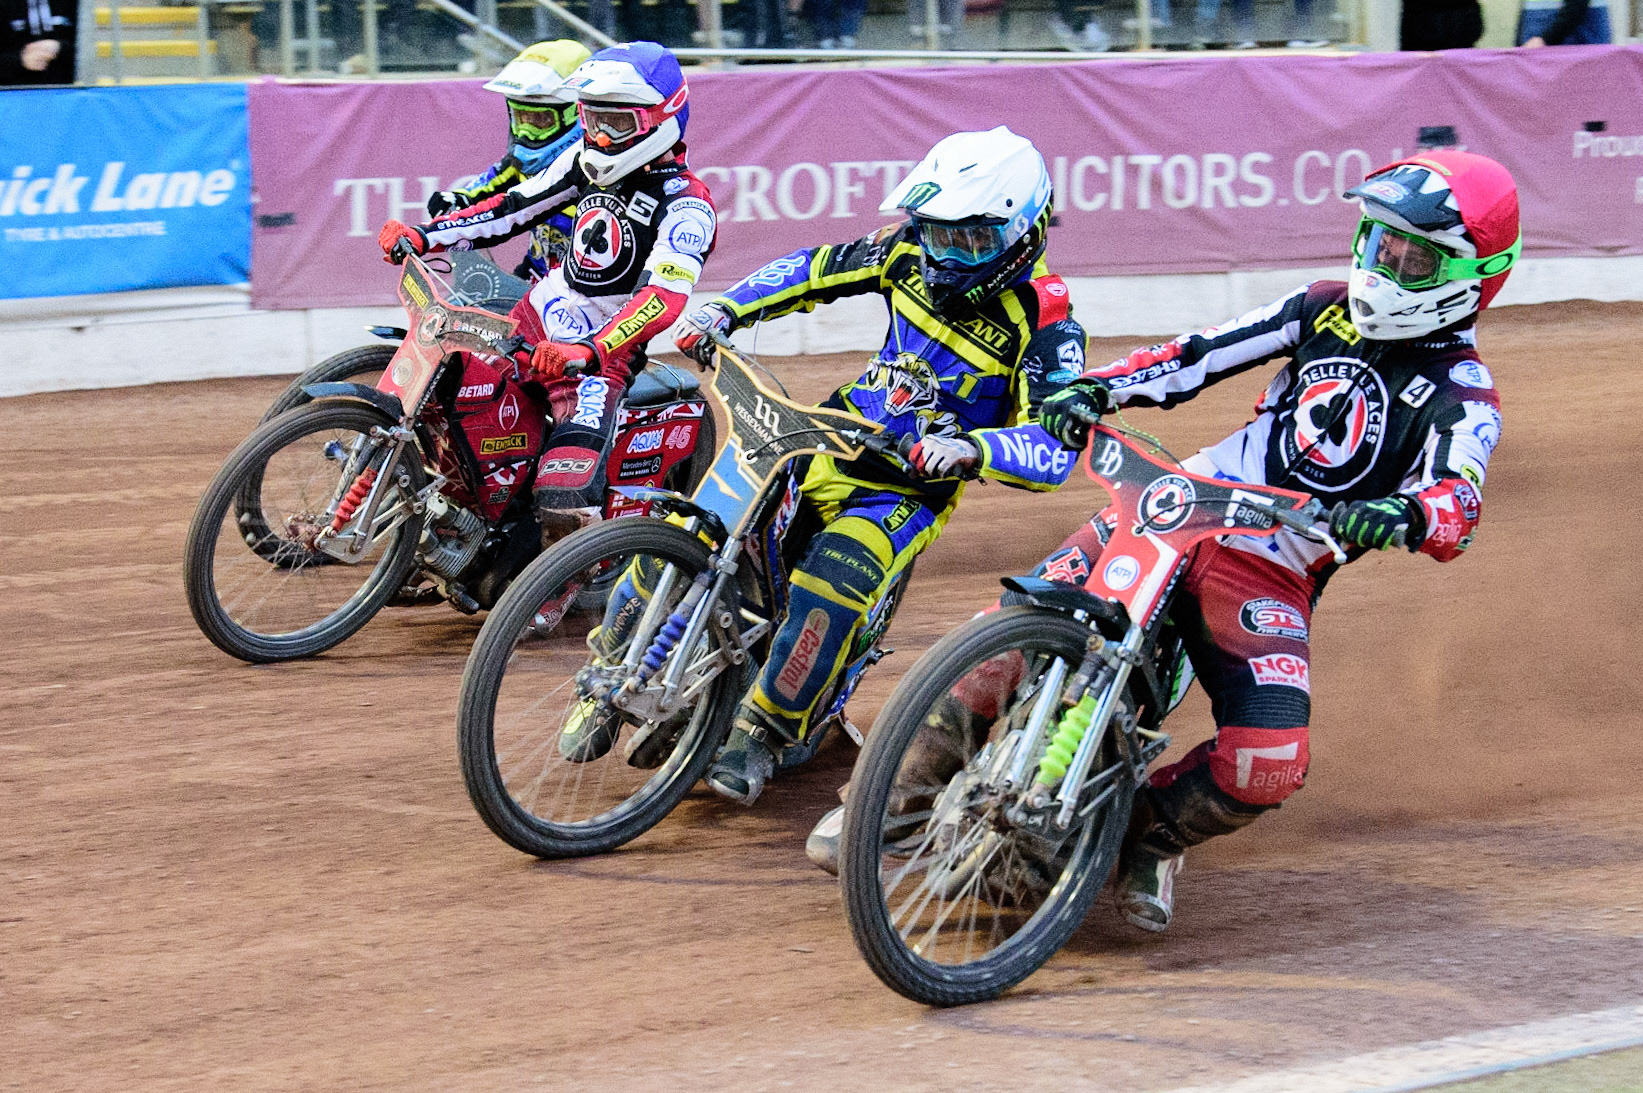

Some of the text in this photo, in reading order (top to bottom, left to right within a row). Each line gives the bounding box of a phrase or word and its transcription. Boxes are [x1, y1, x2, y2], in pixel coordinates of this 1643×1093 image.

[89, 160, 237, 213] Lane
[576, 196, 632, 249] BELLE VUE ACES
[631, 197, 655, 218] 5
[958, 318, 1009, 349] ANT
[457, 383, 494, 398] BETARD
[955, 373, 979, 400] 1
[1408, 381, 1432, 404] 4
[1303, 364, 1347, 387] BELLE
[1365, 400, 1382, 445] ACES
[665, 425, 692, 450] 46
[733, 402, 785, 456] WESSEXMARNE
[996, 432, 1069, 475] Nice
[1256, 610, 1306, 629] STS
[778, 626, 821, 691] Castrol
